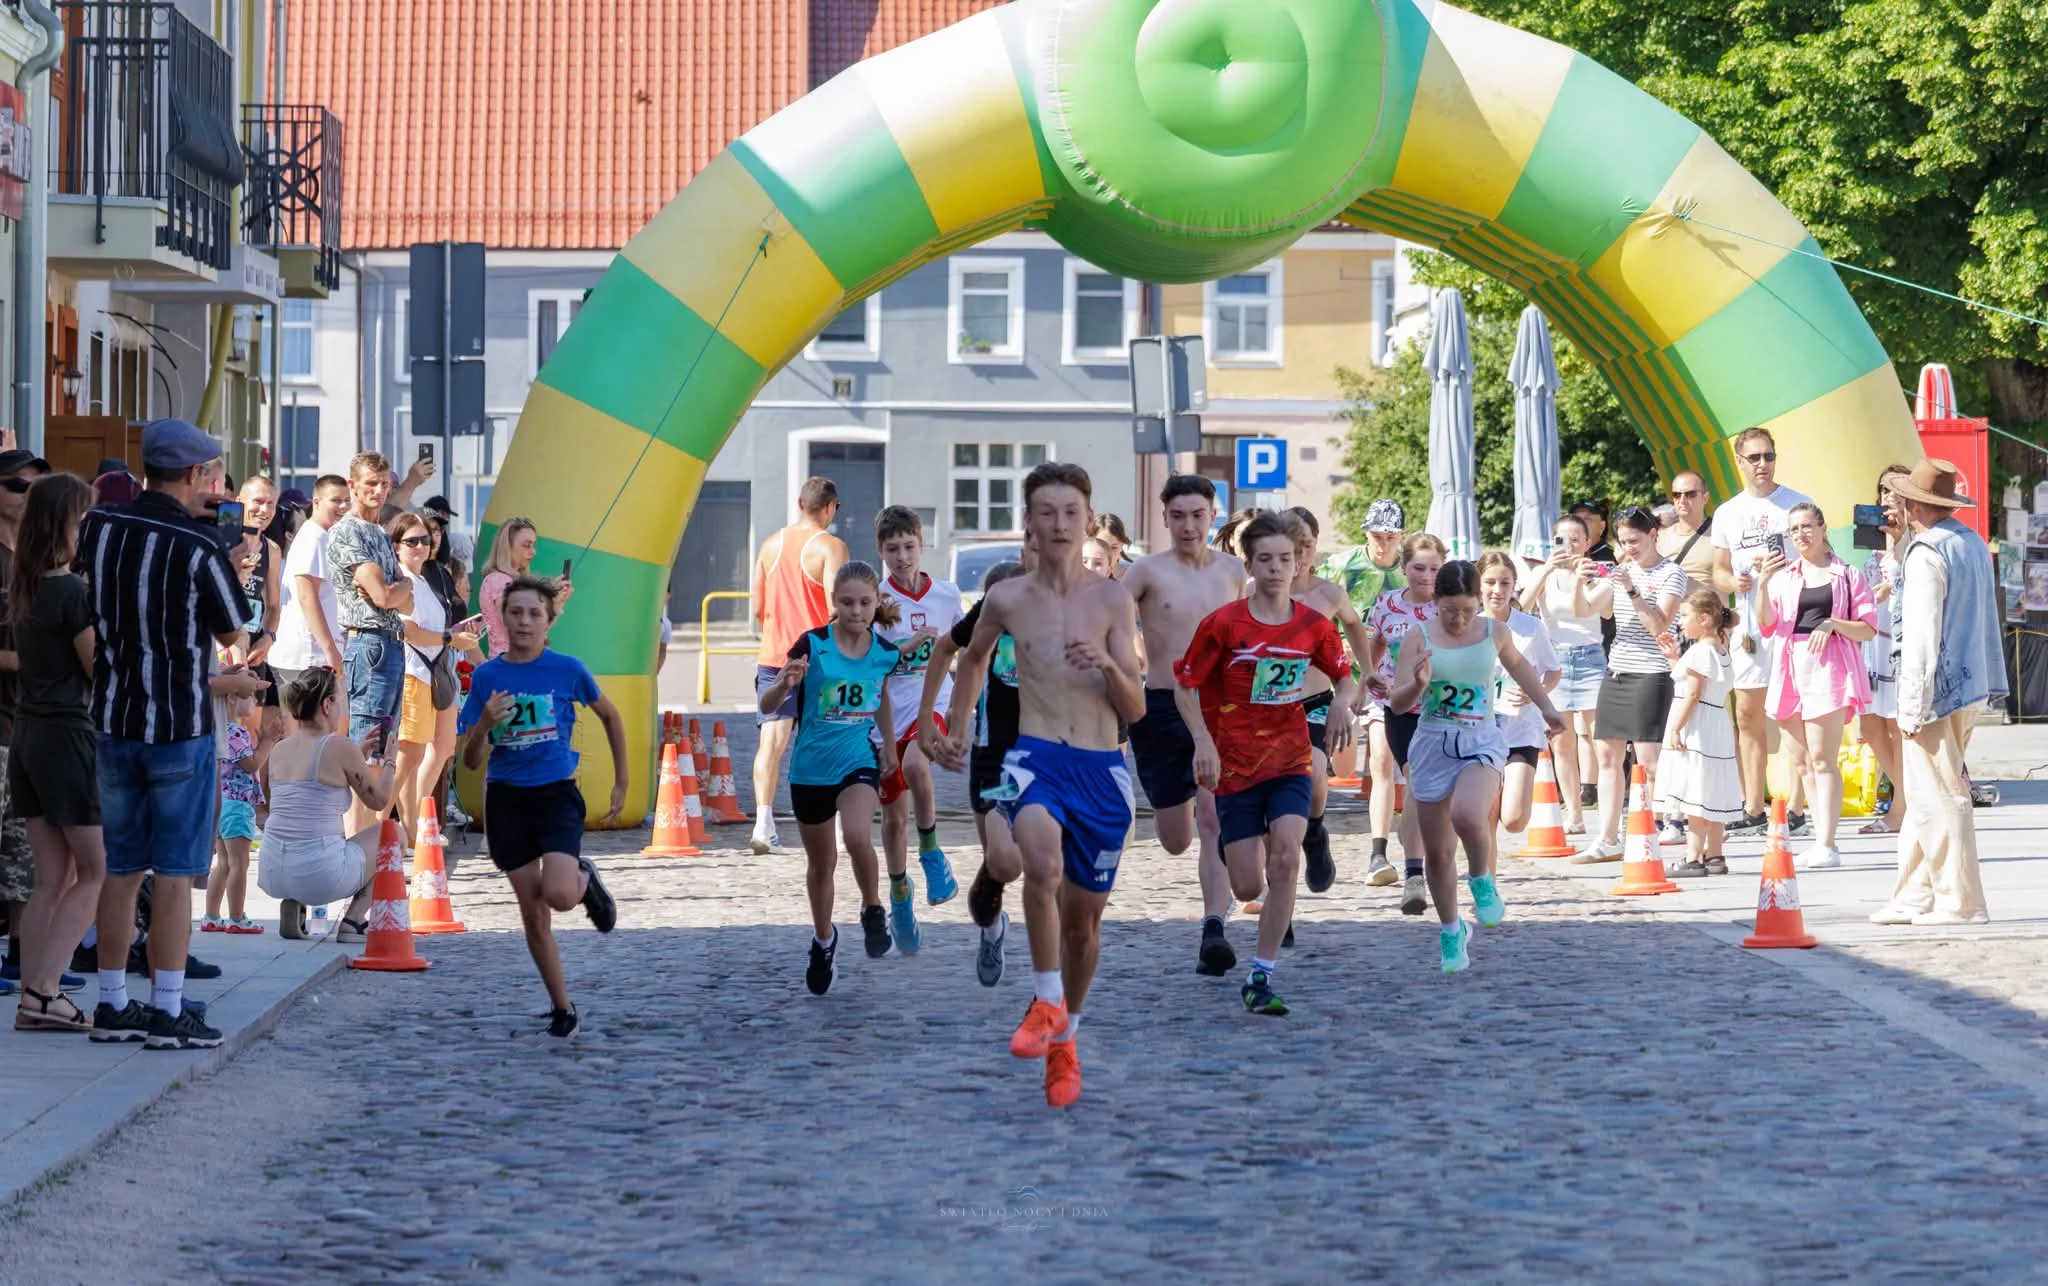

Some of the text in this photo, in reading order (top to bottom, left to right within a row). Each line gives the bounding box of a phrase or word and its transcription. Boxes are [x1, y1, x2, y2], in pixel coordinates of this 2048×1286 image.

[1247, 443, 1279, 485] P
[1267, 663, 1299, 687] 25
[837, 683, 864, 707] 18
[1440, 684, 1475, 711] 22
[507, 701, 537, 726] 21
